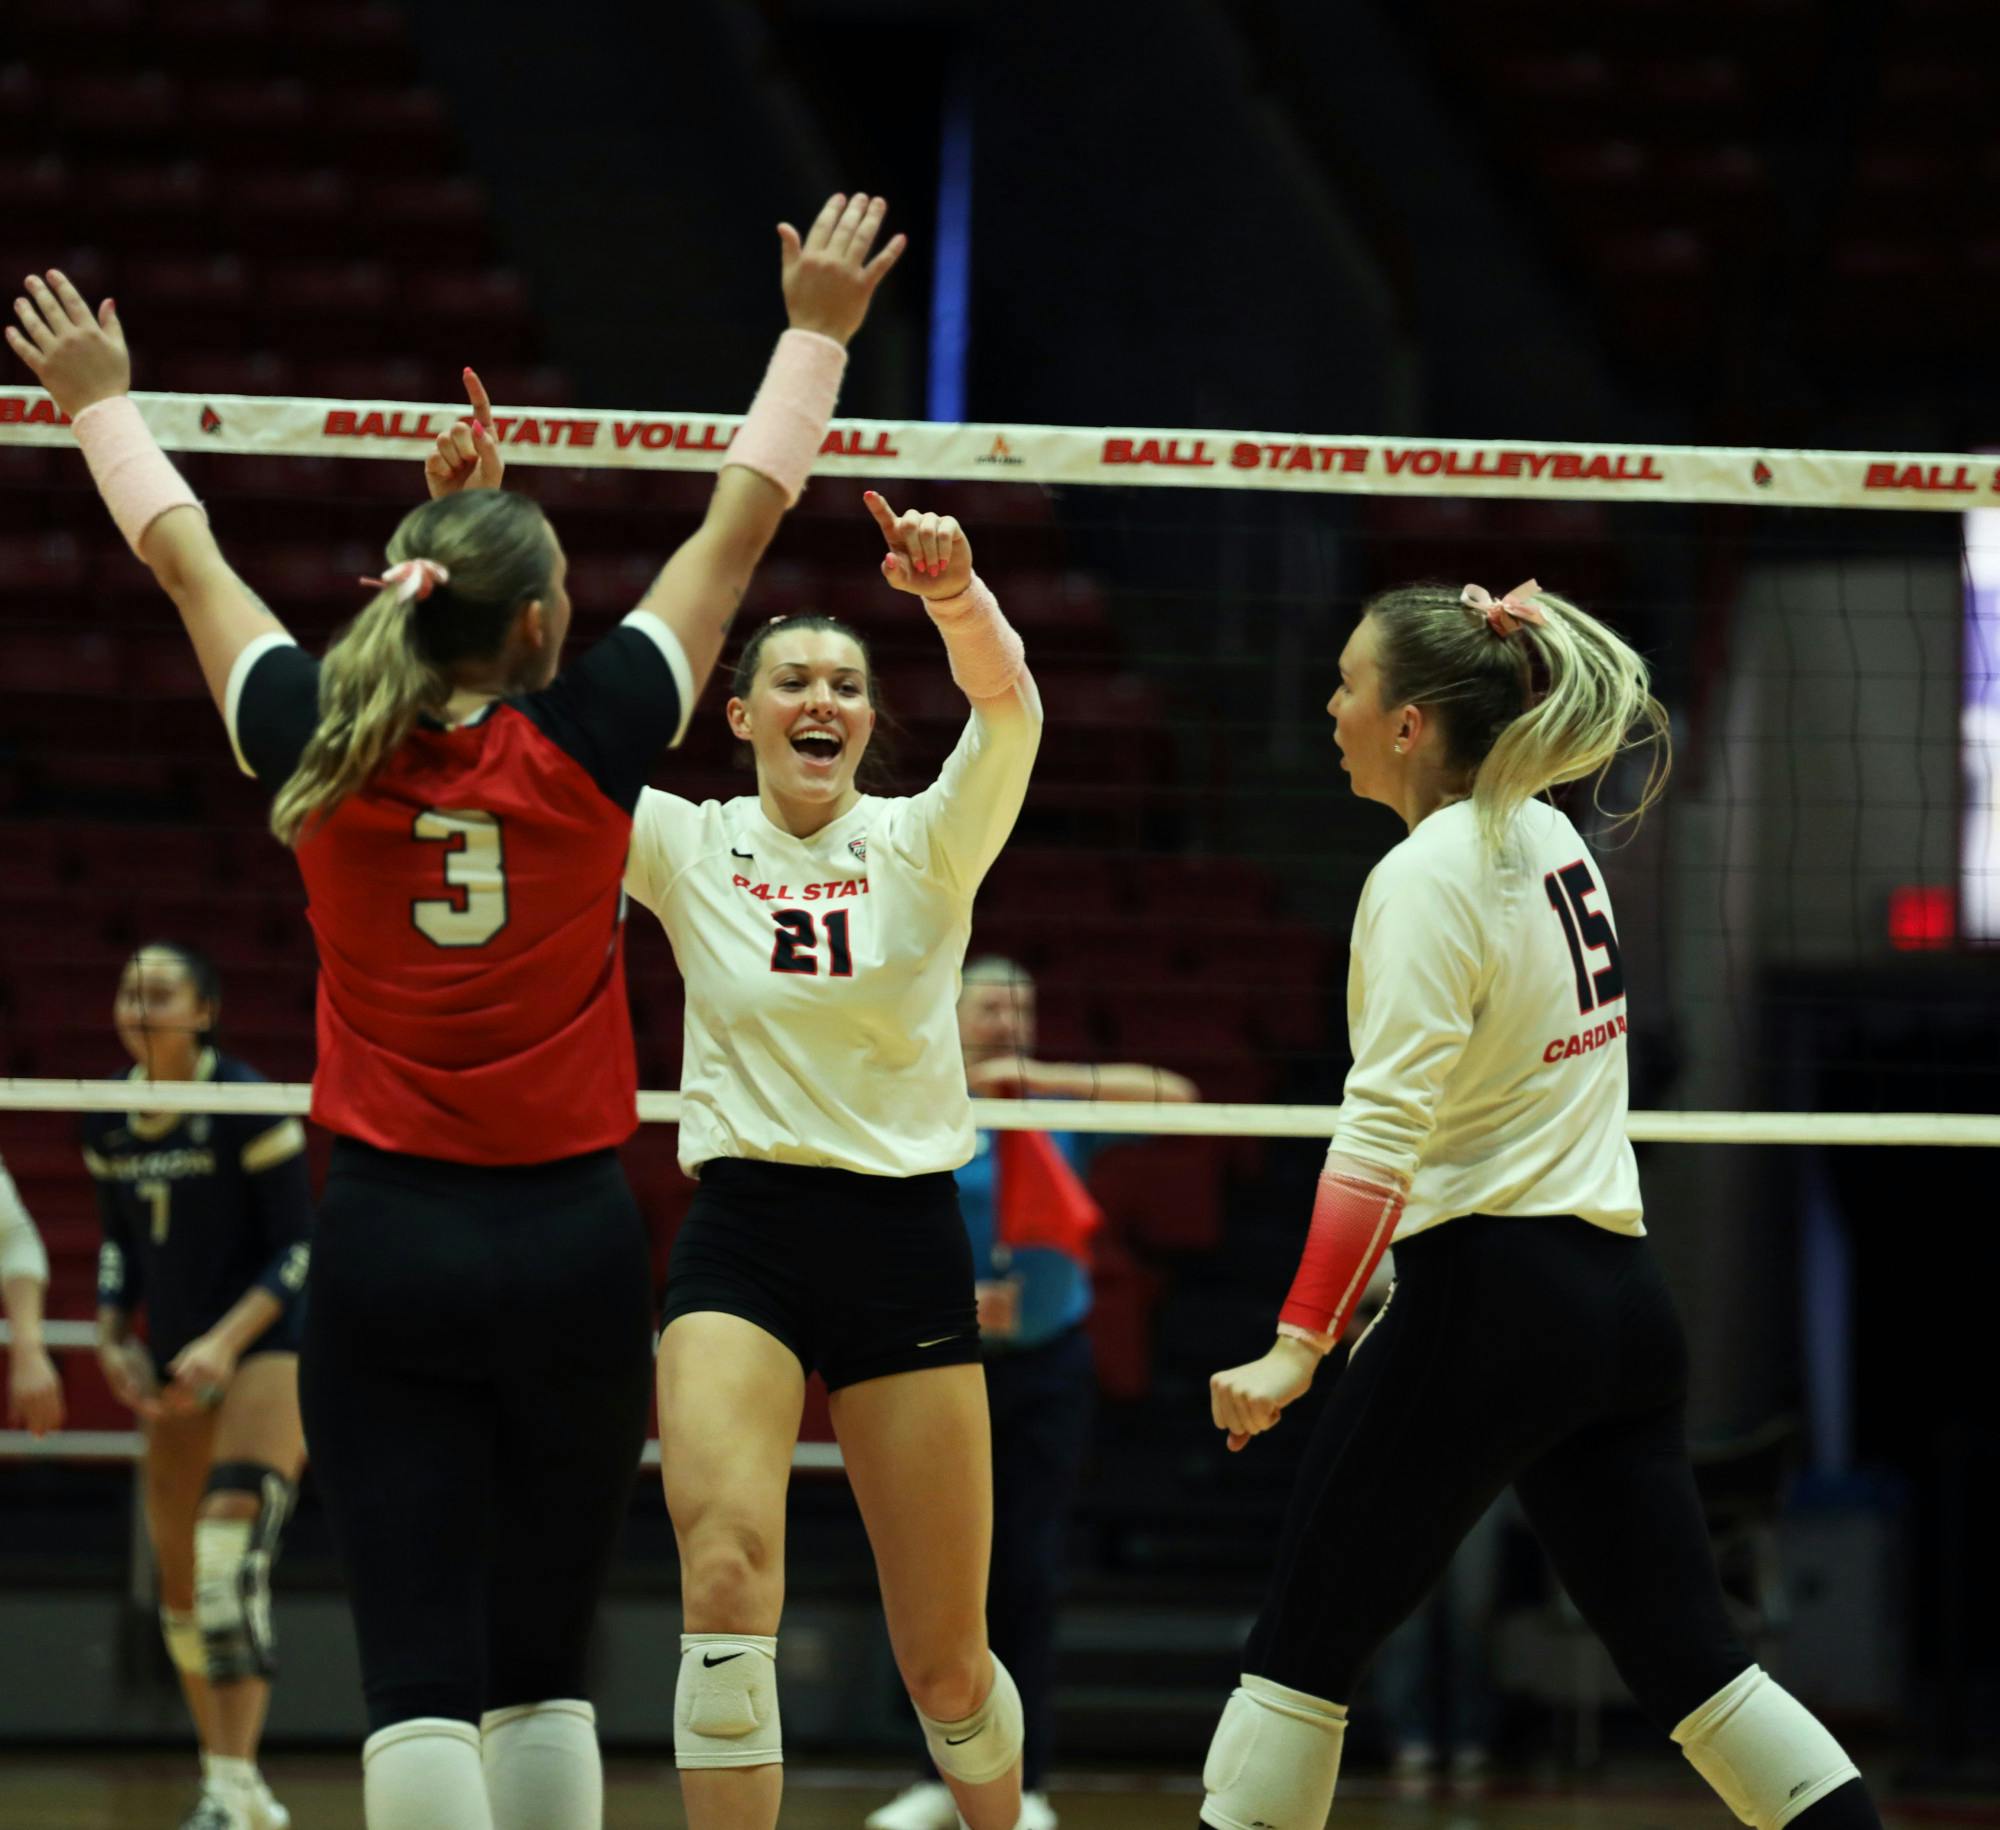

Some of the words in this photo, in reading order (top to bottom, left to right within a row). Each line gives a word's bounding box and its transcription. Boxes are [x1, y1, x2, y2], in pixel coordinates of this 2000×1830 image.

[323, 411, 439, 440] BALL
[1101, 439, 1214, 466] BALL
[1231, 443, 1369, 472] STATE
[1384, 448, 1664, 480] VOLLEYBALL
[1864, 463, 1976, 491] BALL
[411, 809, 508, 947] 3
[770, 908, 853, 977] 21
[1544, 859, 1625, 1016] 15
